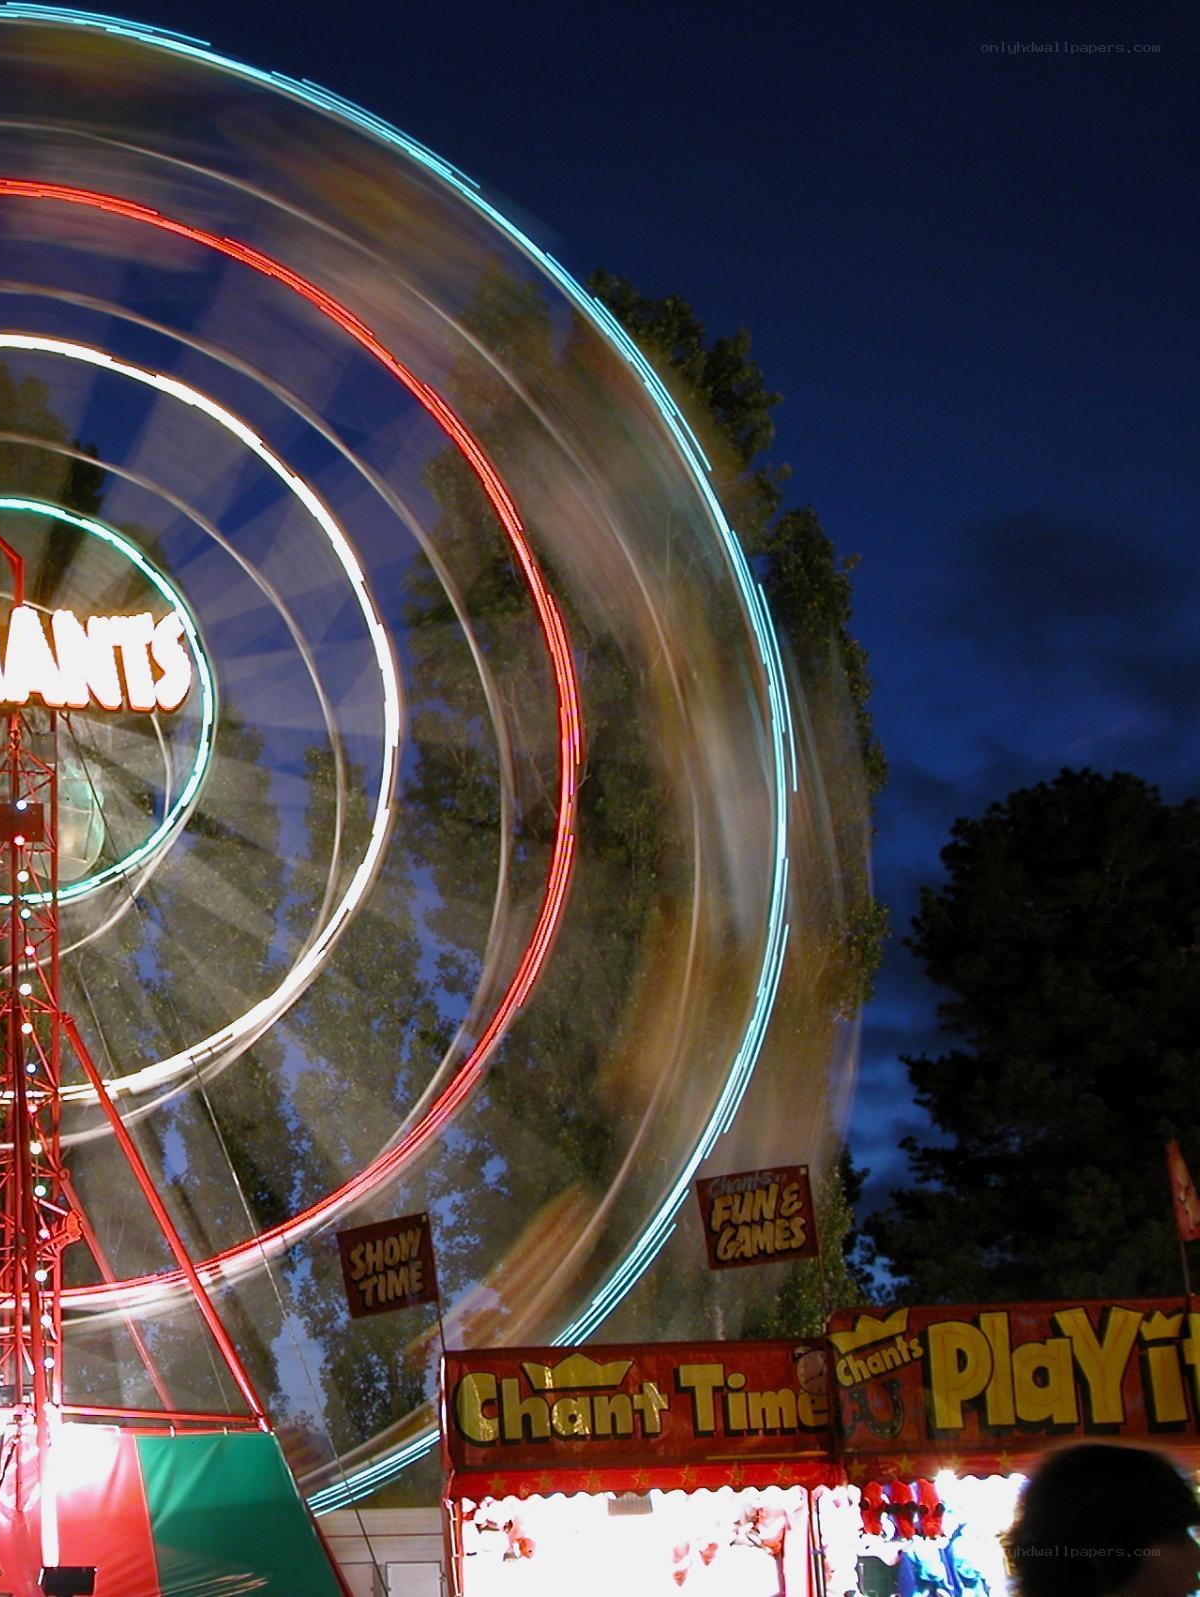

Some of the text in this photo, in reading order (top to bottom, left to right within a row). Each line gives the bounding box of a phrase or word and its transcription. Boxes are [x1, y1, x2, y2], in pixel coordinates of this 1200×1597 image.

[711, 1182, 779, 1232] FUN
[350, 1227, 422, 1280] SHOW
[716, 1216, 807, 1260] GAMES
[359, 1260, 424, 1307] TIME
[836, 1335, 924, 1387] Chants
[455, 1363, 829, 1443] Chant Time
